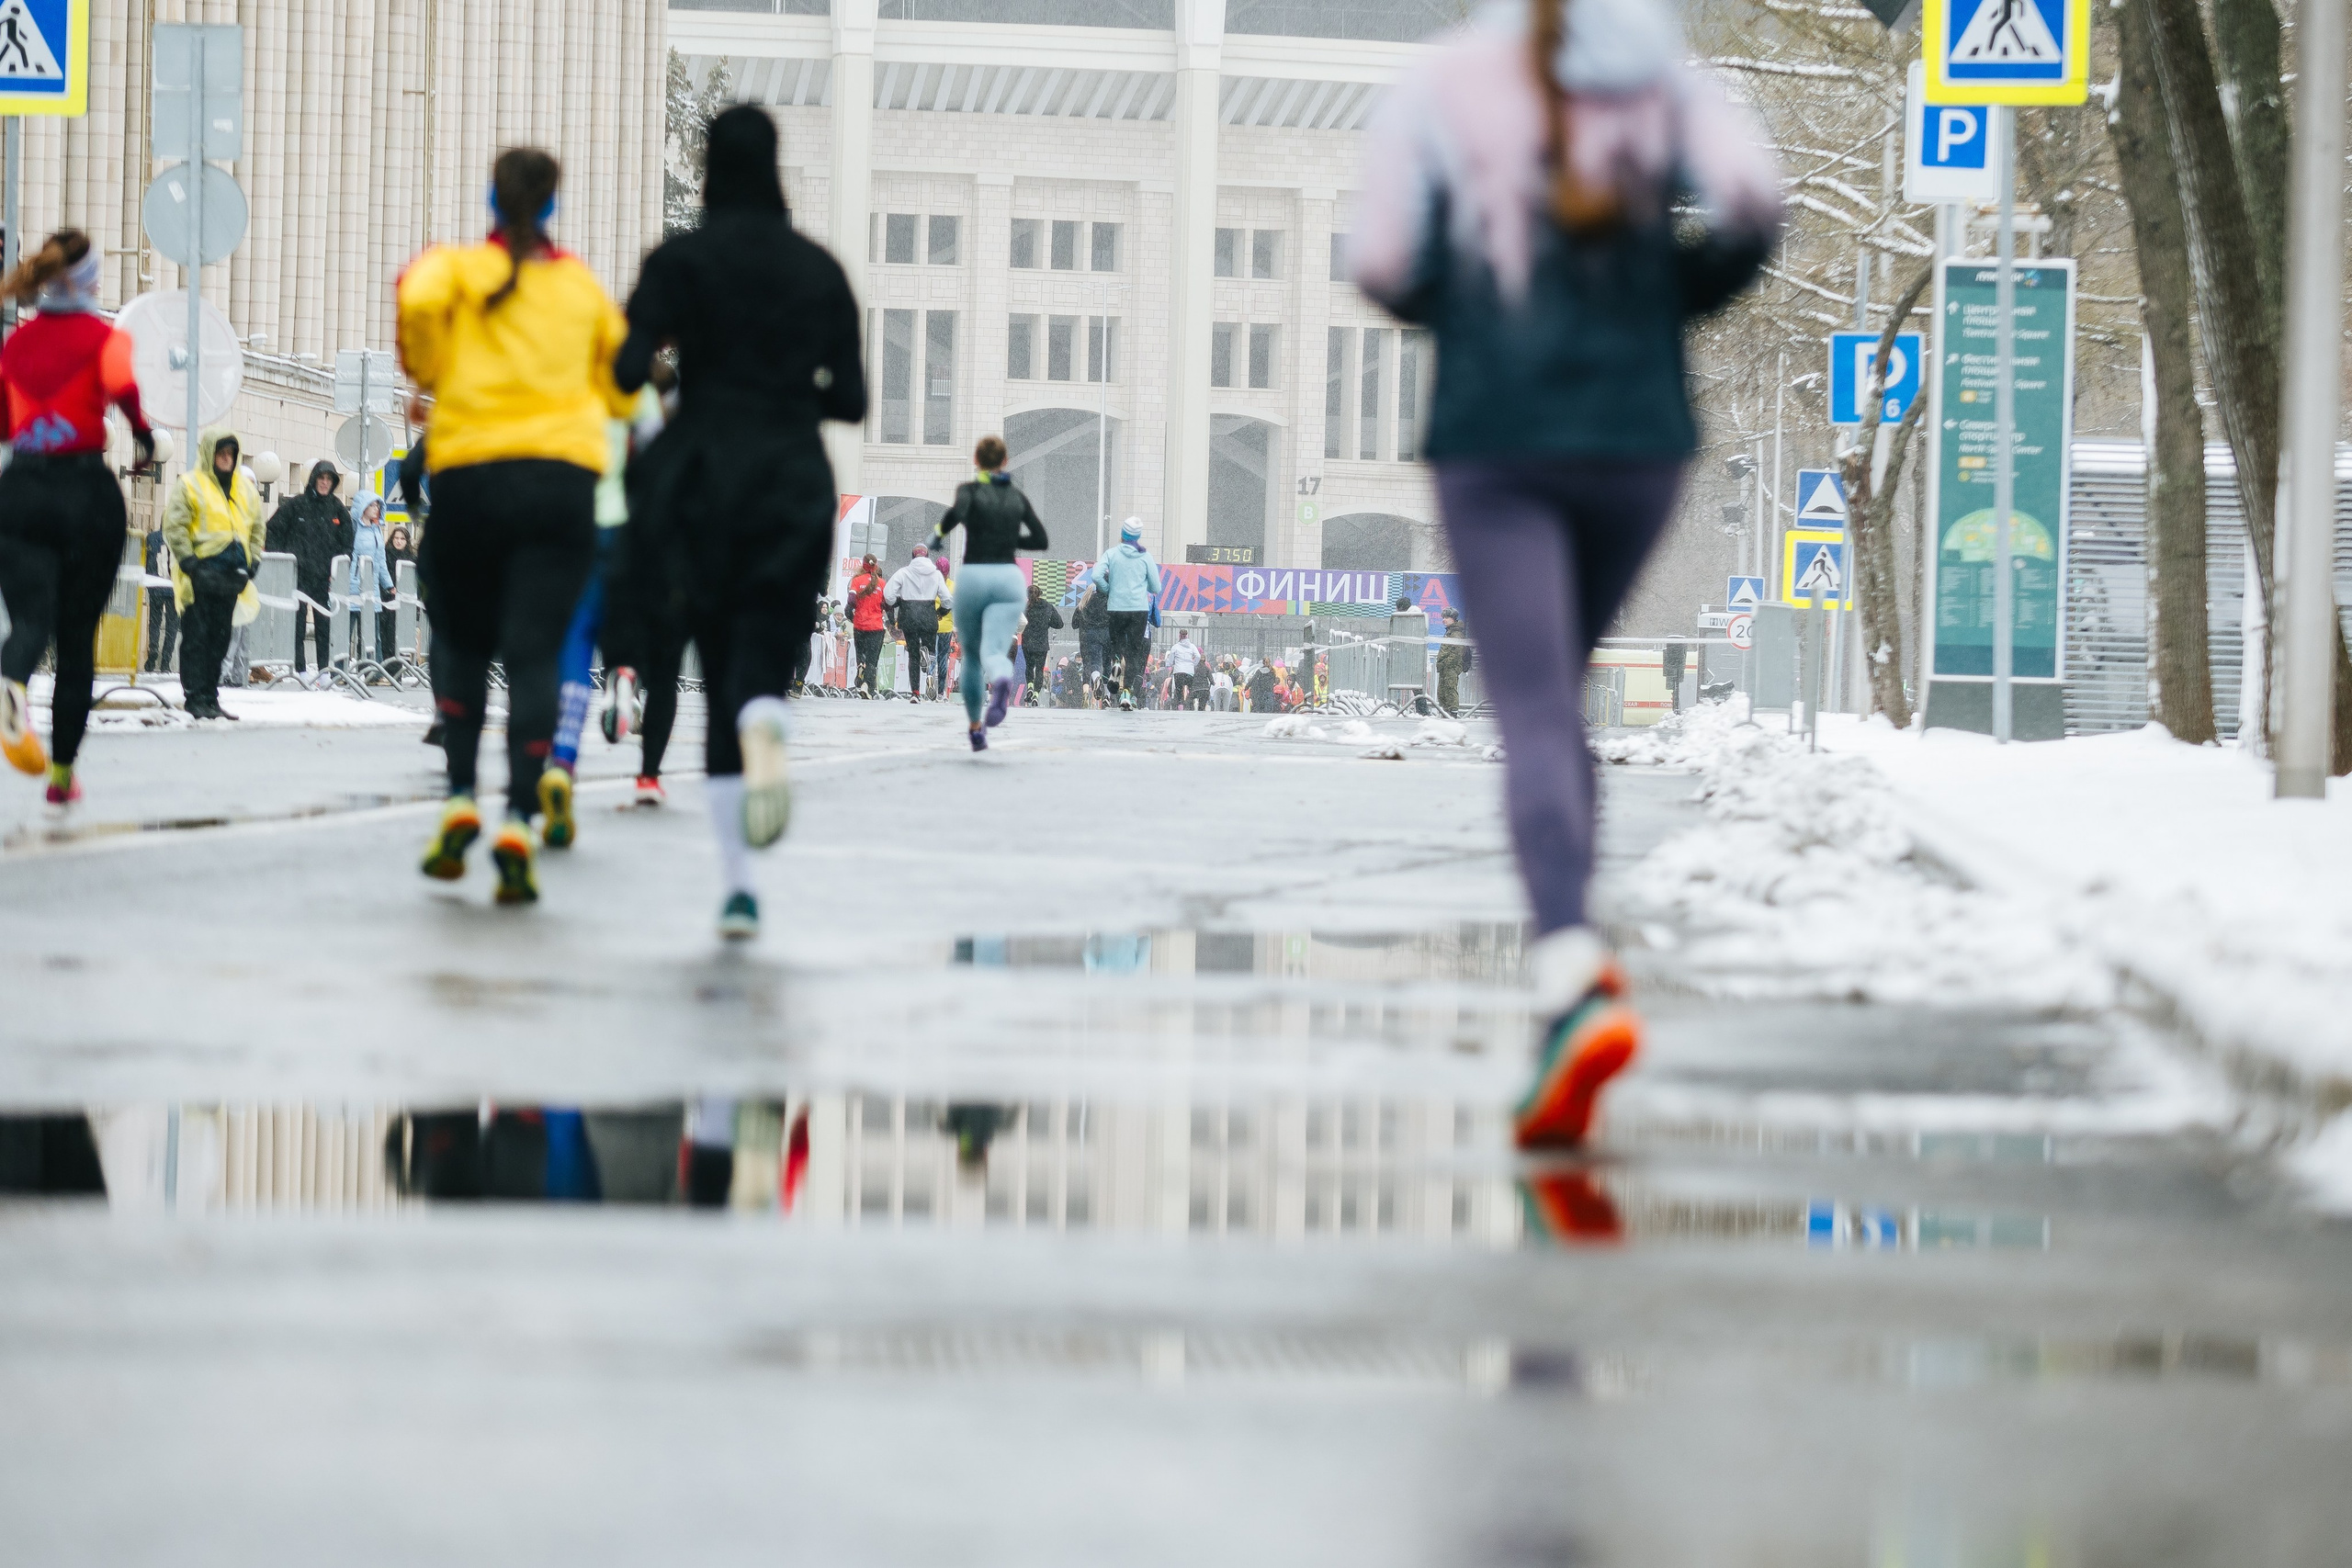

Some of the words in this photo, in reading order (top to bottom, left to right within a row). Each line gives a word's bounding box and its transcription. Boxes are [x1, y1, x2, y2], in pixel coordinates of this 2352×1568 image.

[1937, 108, 1977, 163] P
[1854, 342, 1906, 416] P
[1885, 398, 1901, 418] 6
[1297, 476, 1322, 495] 17
[1236, 570, 1389, 604] ФИНИШ
